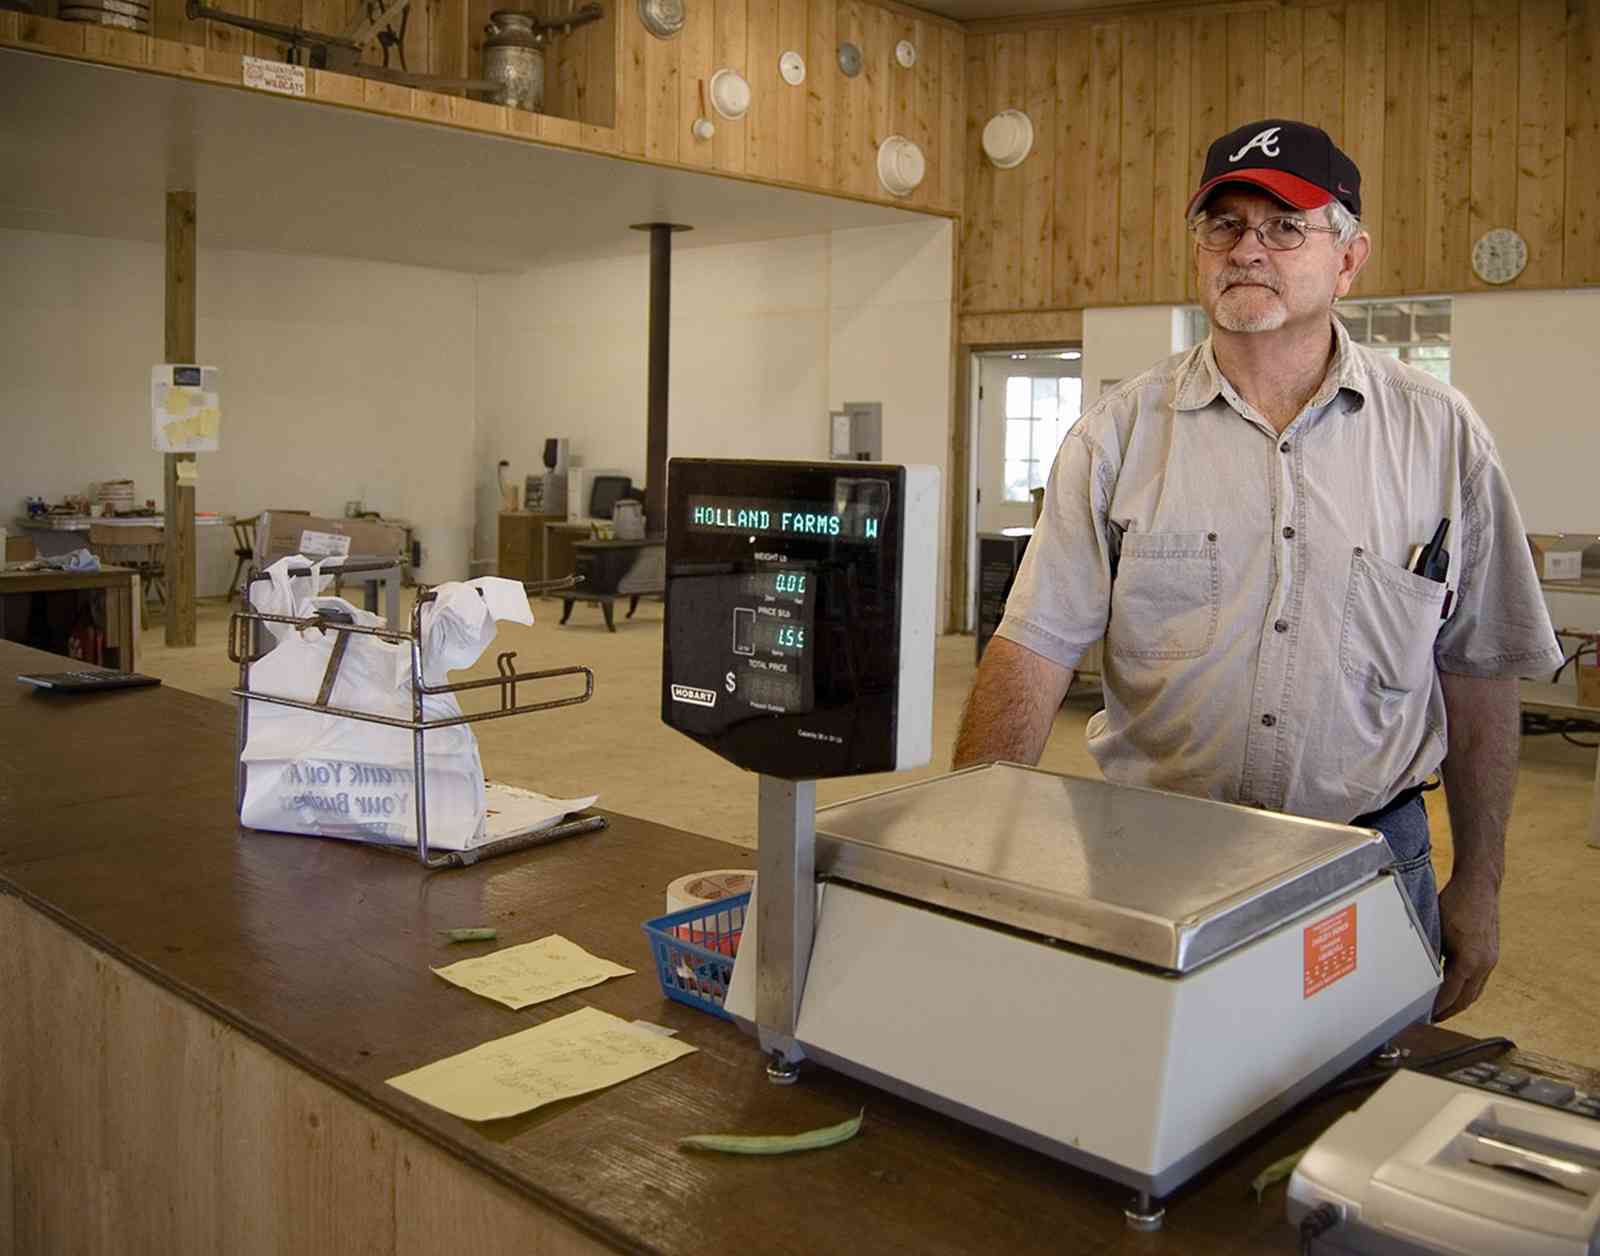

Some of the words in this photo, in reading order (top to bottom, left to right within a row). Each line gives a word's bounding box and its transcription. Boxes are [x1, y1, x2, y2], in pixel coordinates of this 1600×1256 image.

[1229, 127, 1281, 162] A
[694, 506, 770, 530] HOLLAND
[781, 513, 840, 535] FARMS
[865, 519, 878, 538] W
[675, 687, 713, 702] HOBART
[725, 671, 737, 693] $
